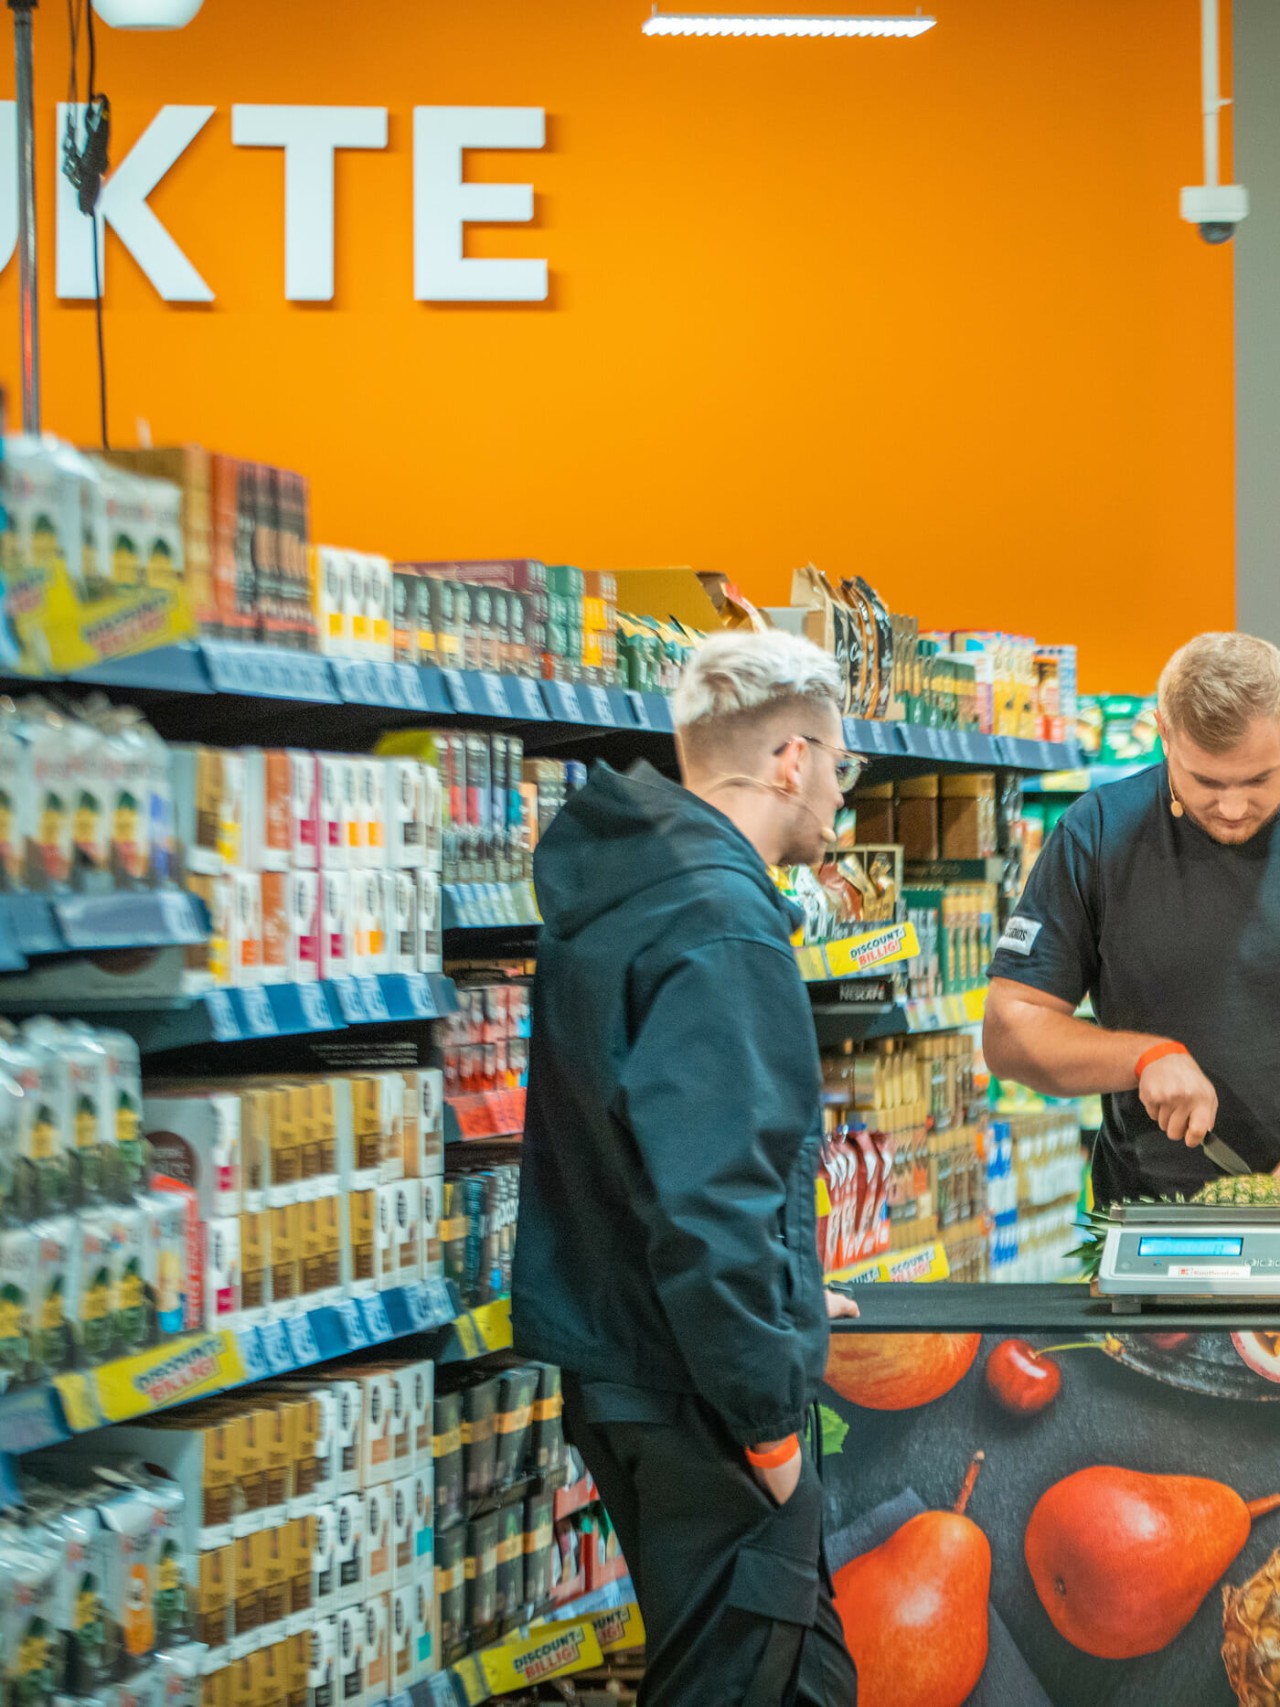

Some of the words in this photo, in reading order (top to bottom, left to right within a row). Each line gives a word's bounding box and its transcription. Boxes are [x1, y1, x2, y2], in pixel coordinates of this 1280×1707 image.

[0, 101, 548, 301] KTE
[859, 939, 900, 966] BILLIG!
[525, 1645, 577, 1679] BILLIG!
